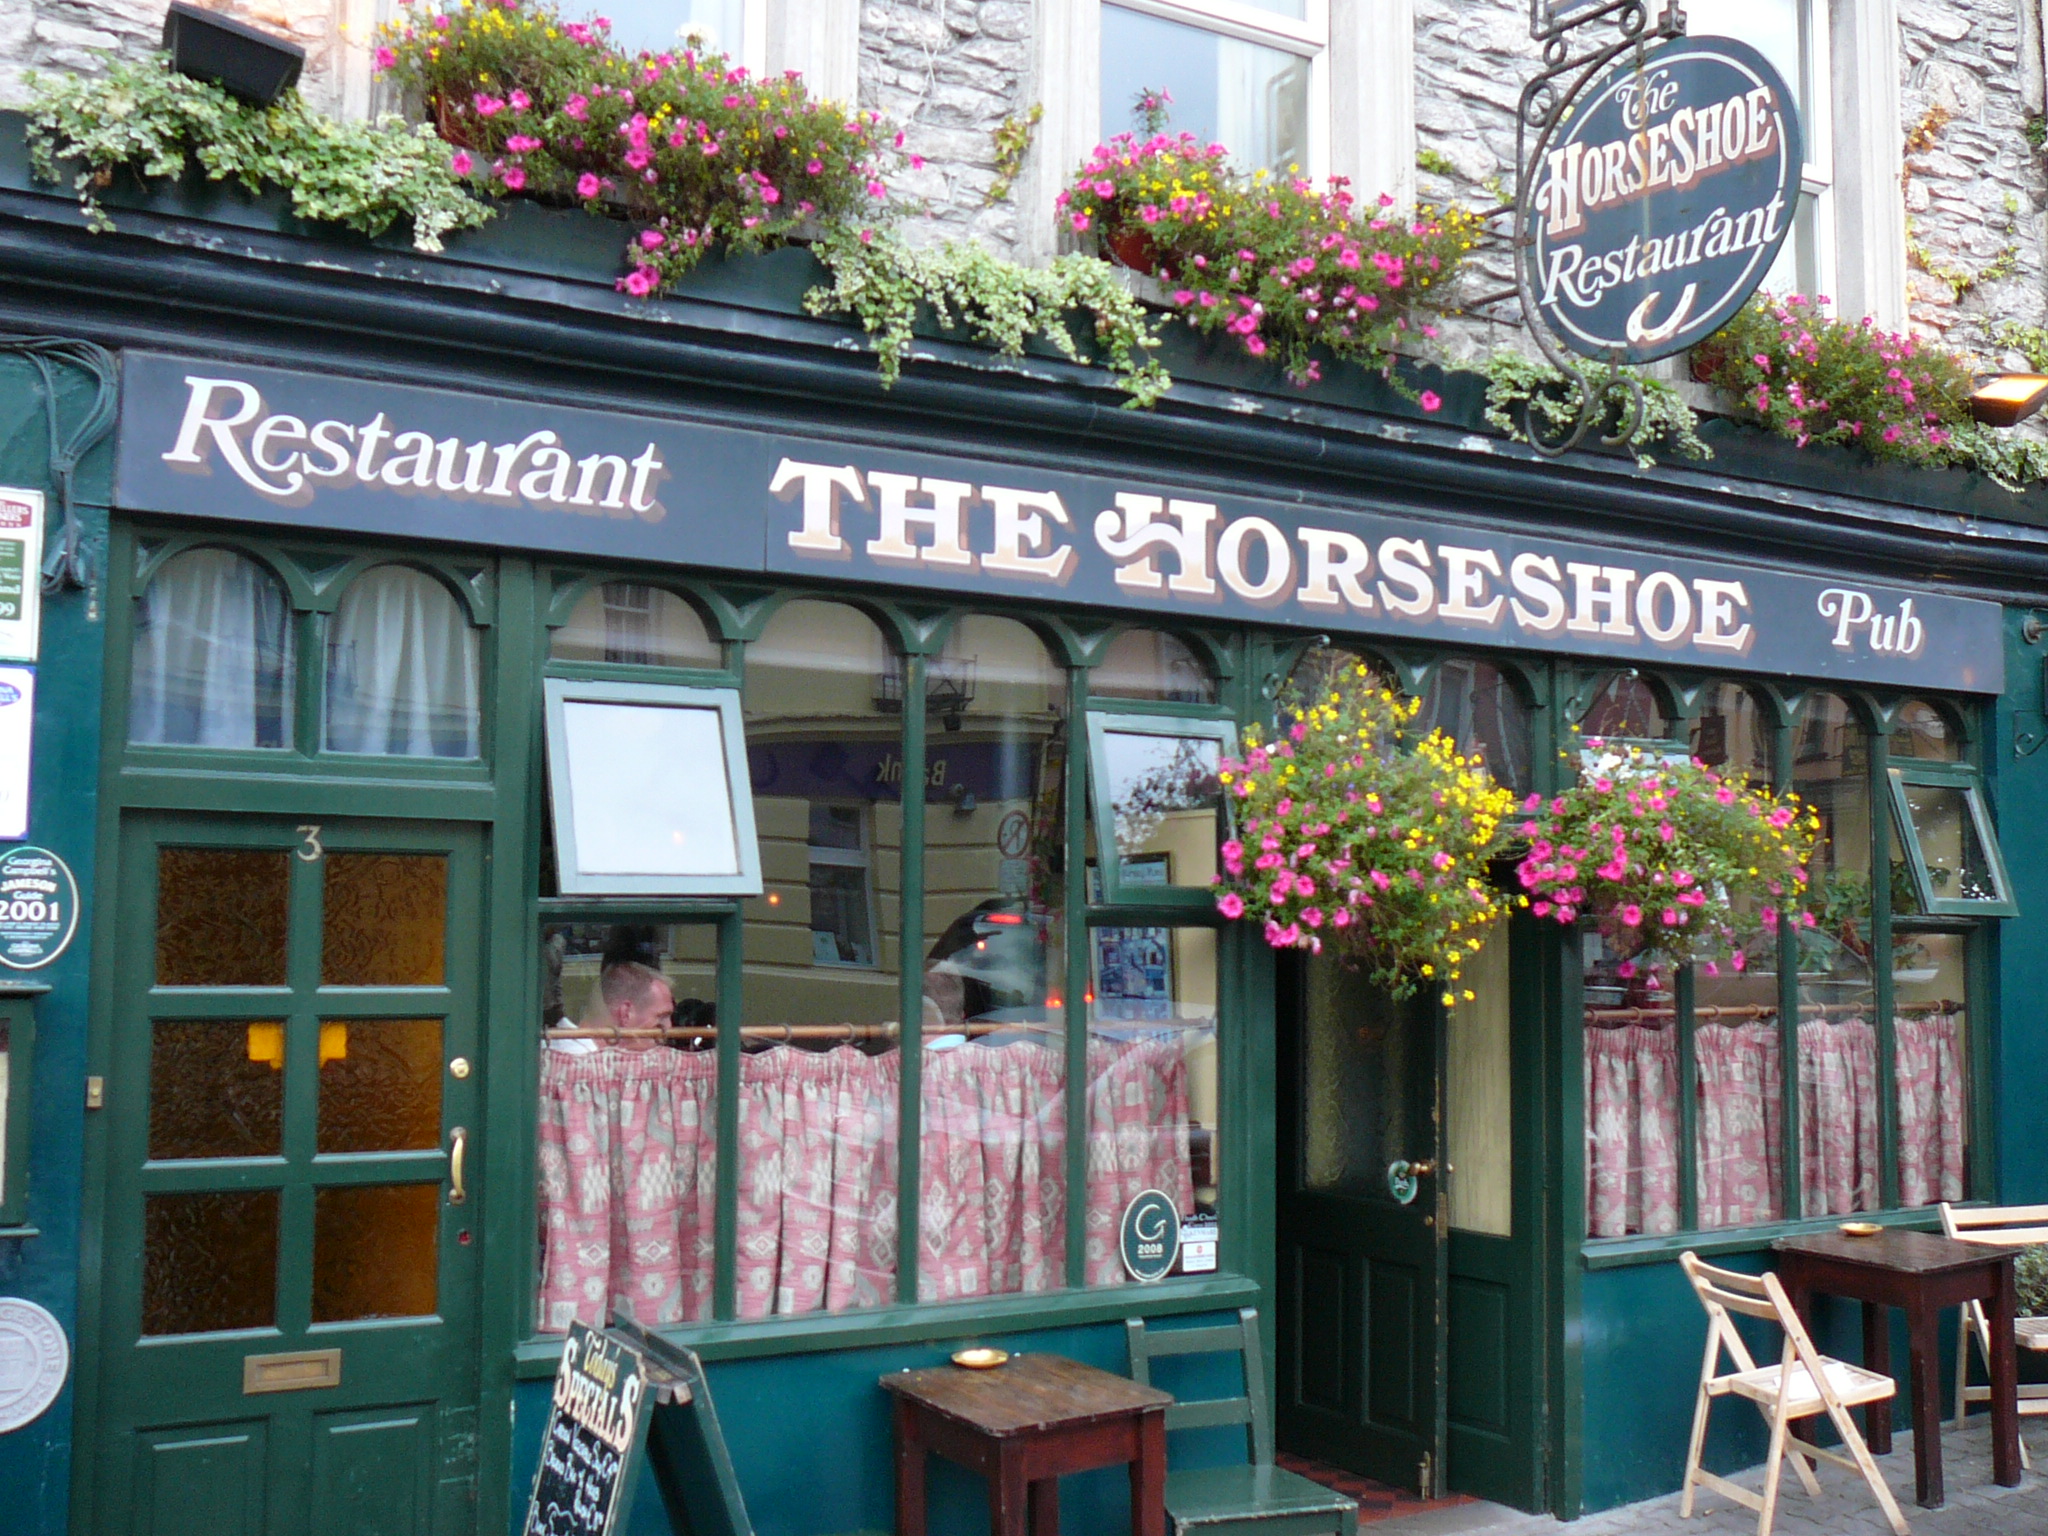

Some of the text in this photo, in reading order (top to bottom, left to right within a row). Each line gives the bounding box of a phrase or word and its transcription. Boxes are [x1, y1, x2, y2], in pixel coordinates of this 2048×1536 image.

[1616, 69, 1679, 130] The
[1536, 86, 1774, 235] HORSESHOE
[1540, 191, 1784, 307] Restaurant
[161, 376, 1923, 655] Restaurant THE HORSESHOE Pub
[296, 825, 322, 861] 3
[0, 878, 57, 893] JAMESON
[0, 900, 59, 921] 2001
[1137, 1243, 1163, 1254] 2008
[554, 1336, 641, 1452] SPECIALS
